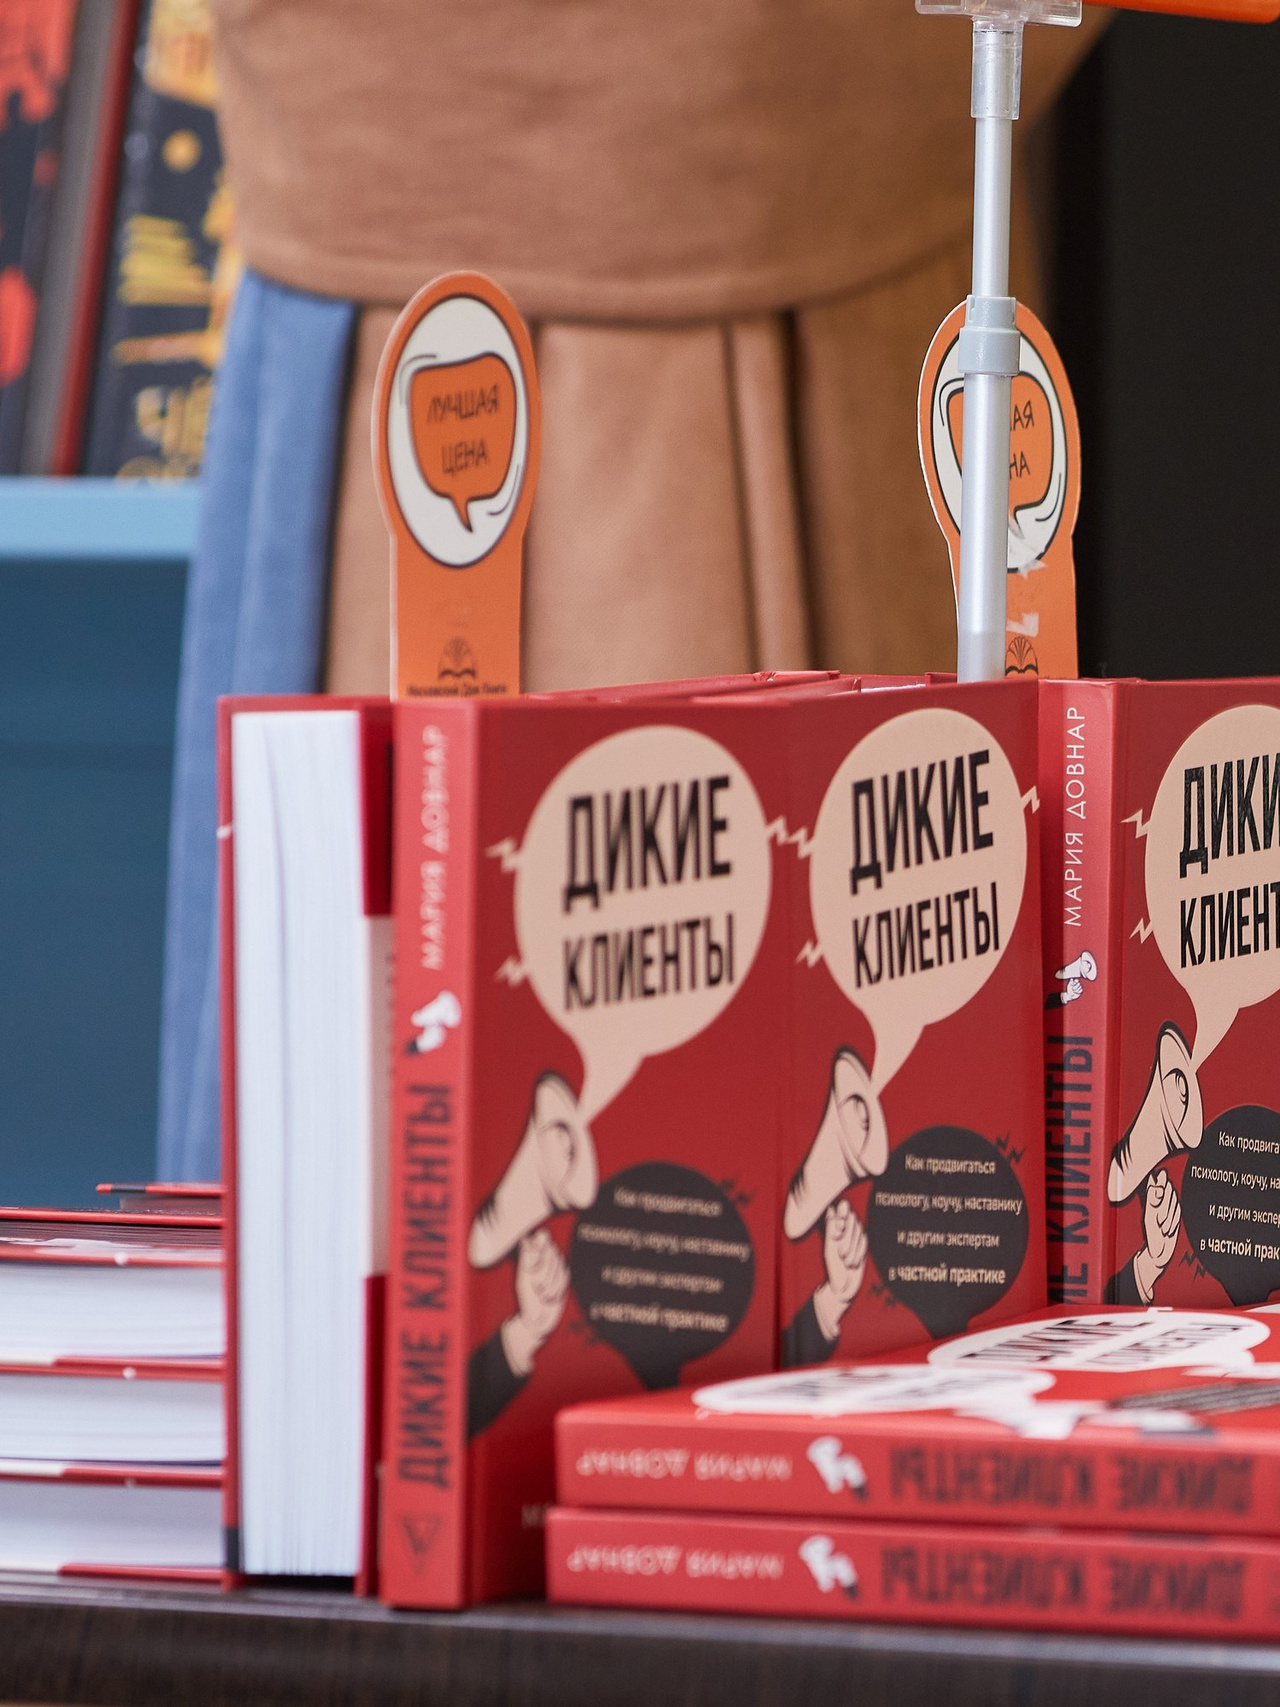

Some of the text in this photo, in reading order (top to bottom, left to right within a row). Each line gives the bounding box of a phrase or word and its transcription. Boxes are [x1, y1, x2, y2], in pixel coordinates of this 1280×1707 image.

[427, 384, 498, 423] ЛУЧШАЯ
[442, 439, 489, 476] ЦЕНА
[850, 750, 993, 895] ДИКИЕ
[1064, 707, 1087, 927] МАРИЯ ДОВНАР
[564, 775, 730, 912] ДИКИЕ
[853, 882, 999, 989] КЛИЕНТЫ
[564, 913, 733, 1012] КЛИЕНТЫ
[1045, 1035, 1093, 1245] КЛИЕНТЫ
[1219, 1131, 1235, 1147] Как
[905, 1154, 996, 1175] Как продвигаться
[964, 1198, 1023, 1216] наставнику
[1209, 1205, 1215, 1216] и
[1217, 1205, 1251, 1222] другим
[897, 1229, 1000, 1250] и другим экспертам
[1200, 1239, 1206, 1251] в
[1208, 1237, 1252, 1256] частной
[397, 1084, 452, 1490] ДИКИЕ КЛИЕНТЫ
[889, 1262, 1006, 1287] в частной практике
